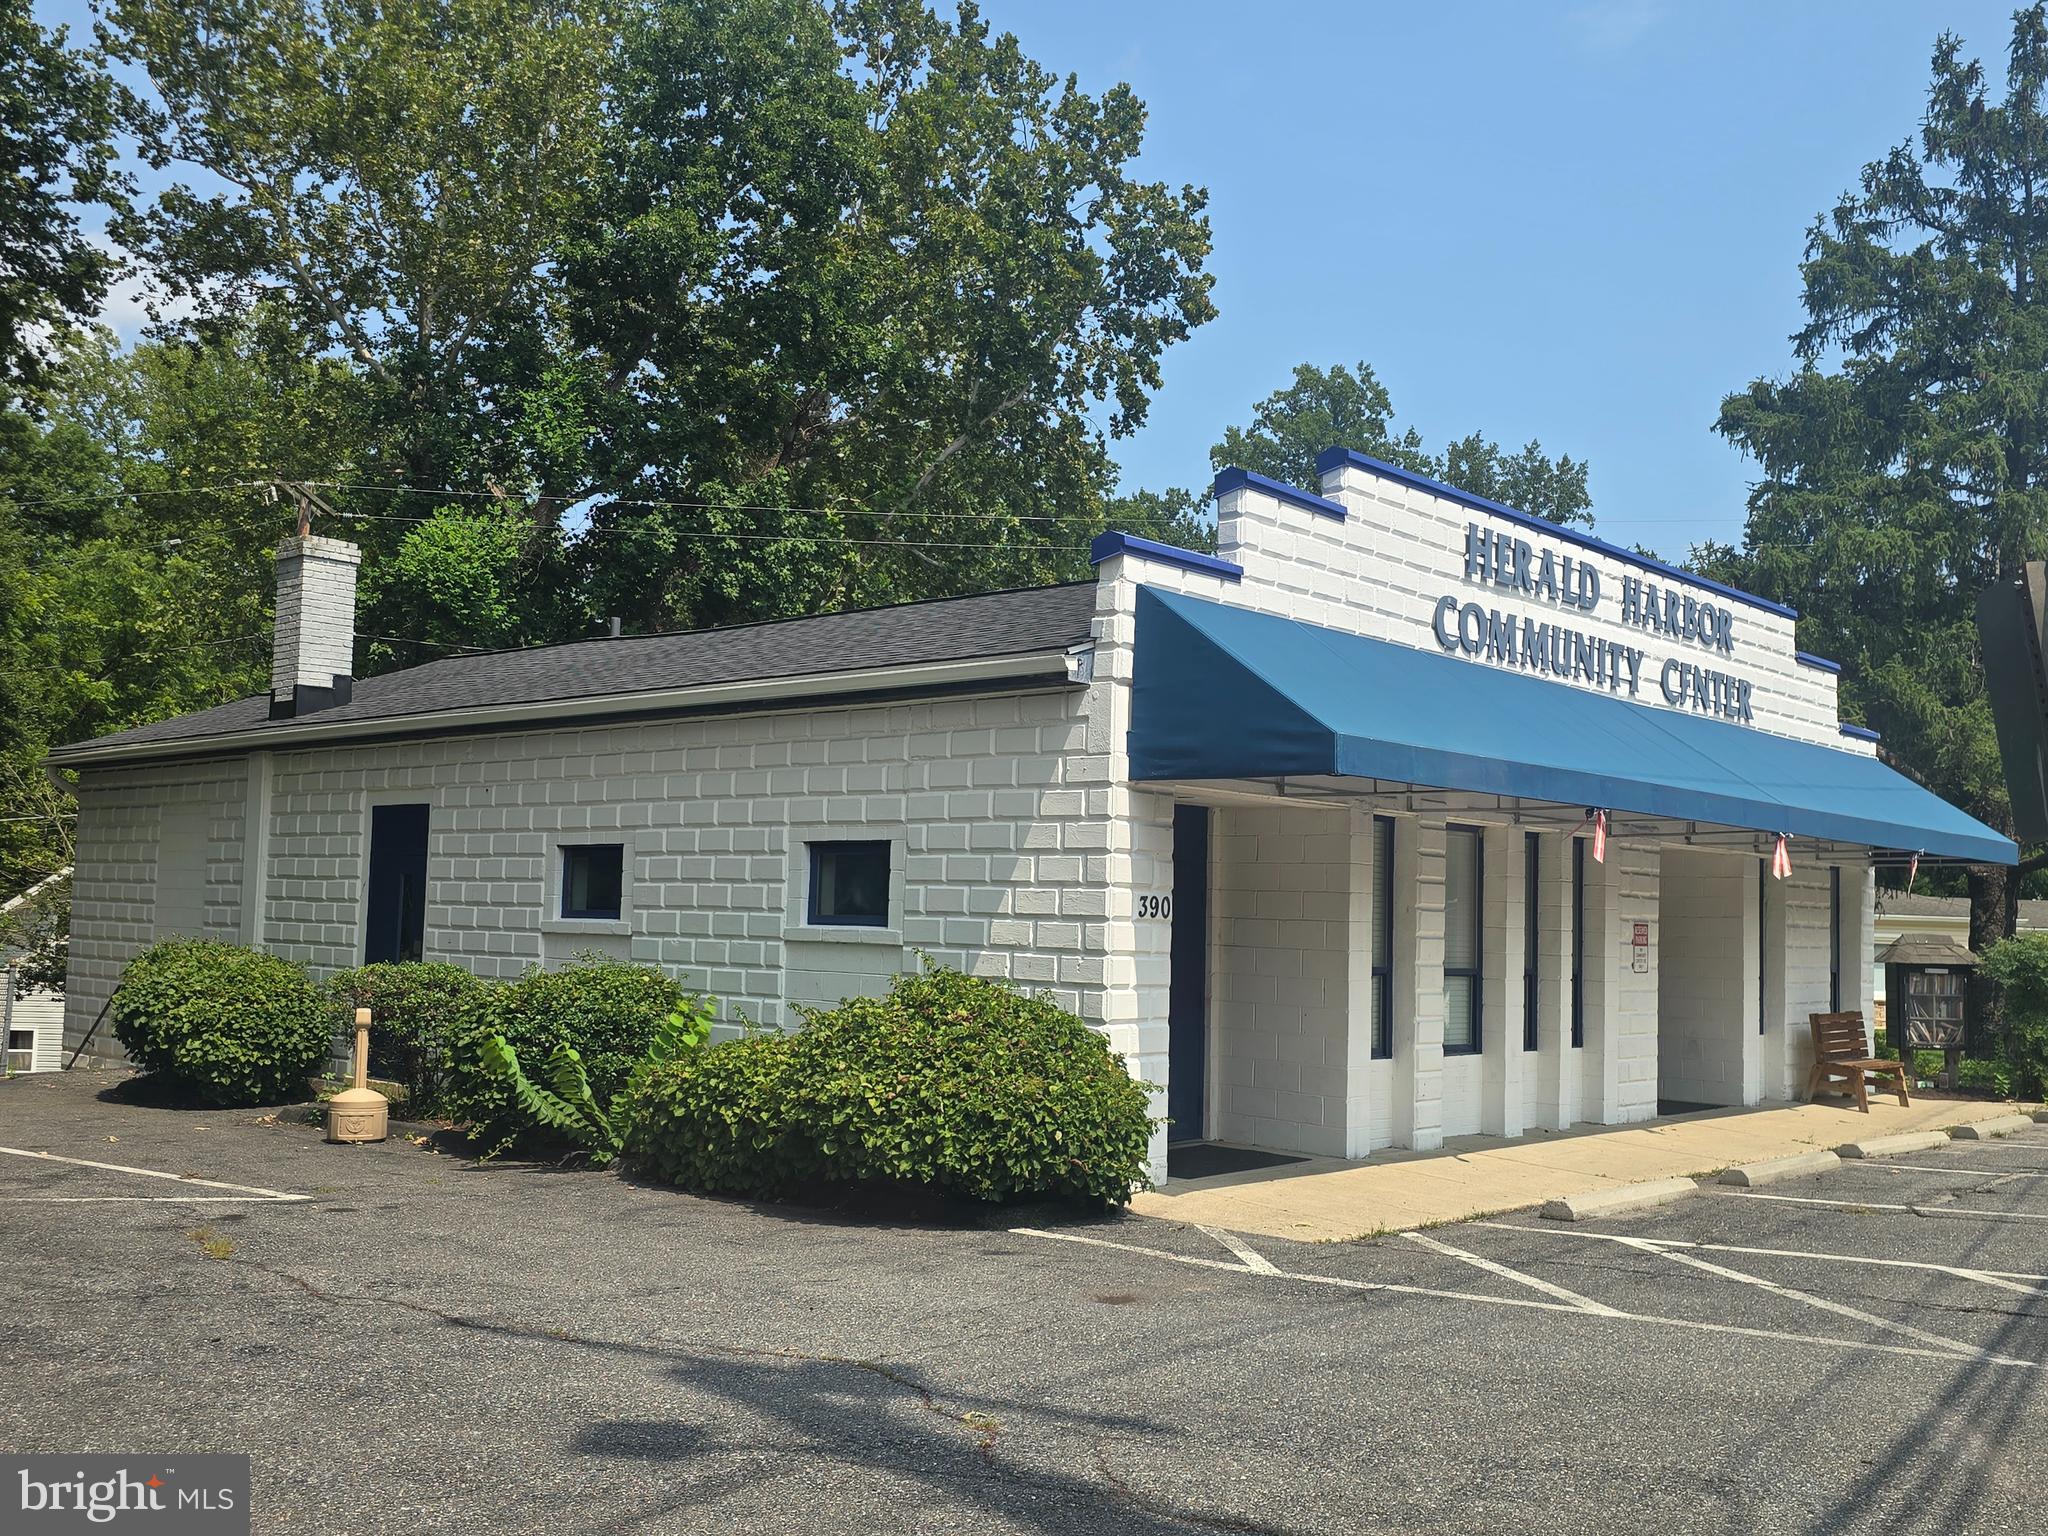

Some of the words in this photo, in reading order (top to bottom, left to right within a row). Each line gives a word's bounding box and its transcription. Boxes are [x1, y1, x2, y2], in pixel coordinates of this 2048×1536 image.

[1467, 522, 1601, 610] HERALD
[1622, 575, 1735, 651] HARBOR
[1434, 595, 1645, 693] COMMUNITY
[1661, 658, 1754, 720] CENTER
[1138, 895, 1171, 919] 390
